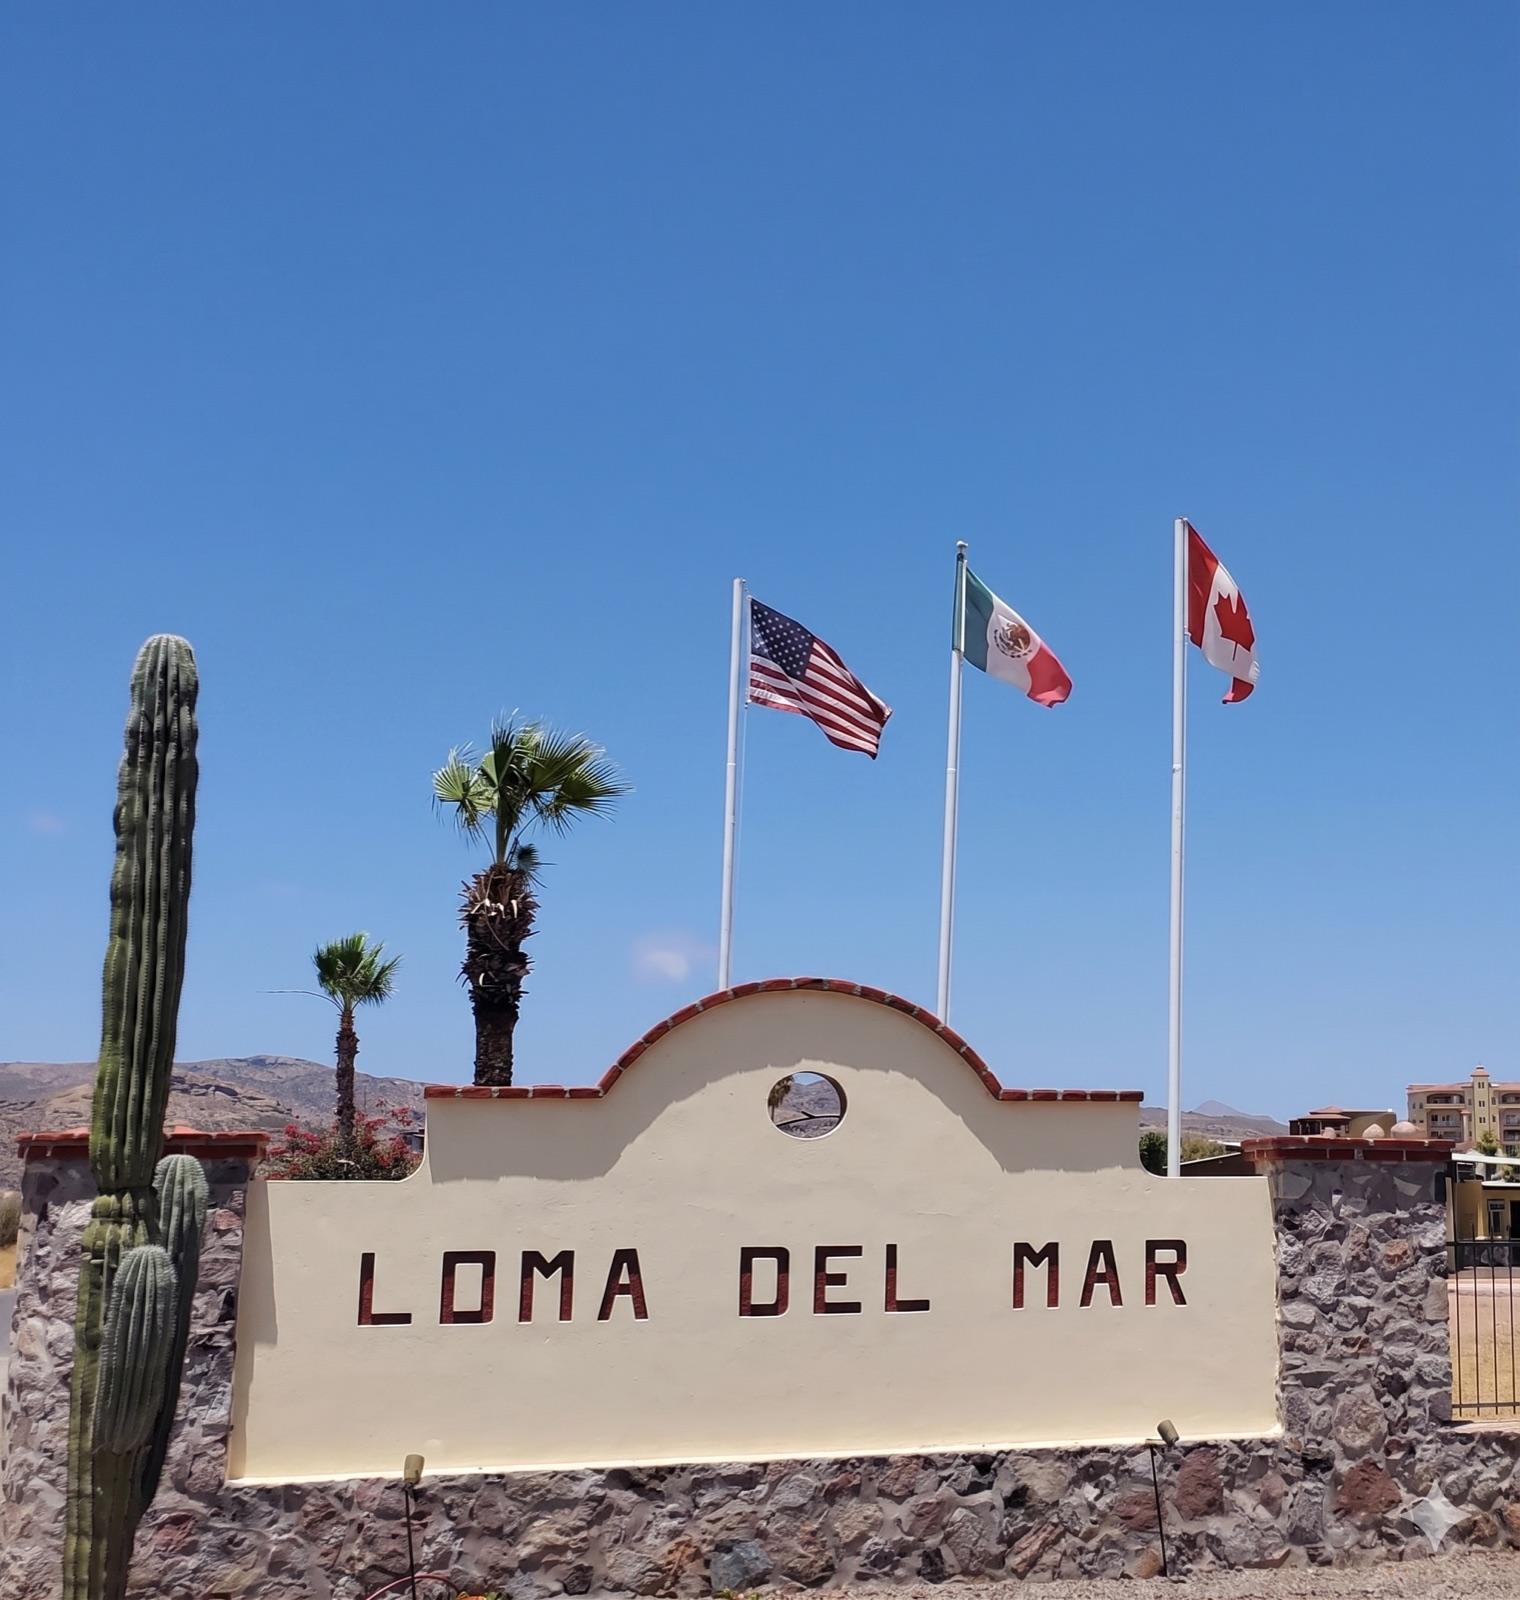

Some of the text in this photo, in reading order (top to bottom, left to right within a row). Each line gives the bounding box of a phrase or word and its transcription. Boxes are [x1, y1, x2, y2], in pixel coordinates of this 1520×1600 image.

[357, 1239, 1188, 1326] LOMA DEL MAR
